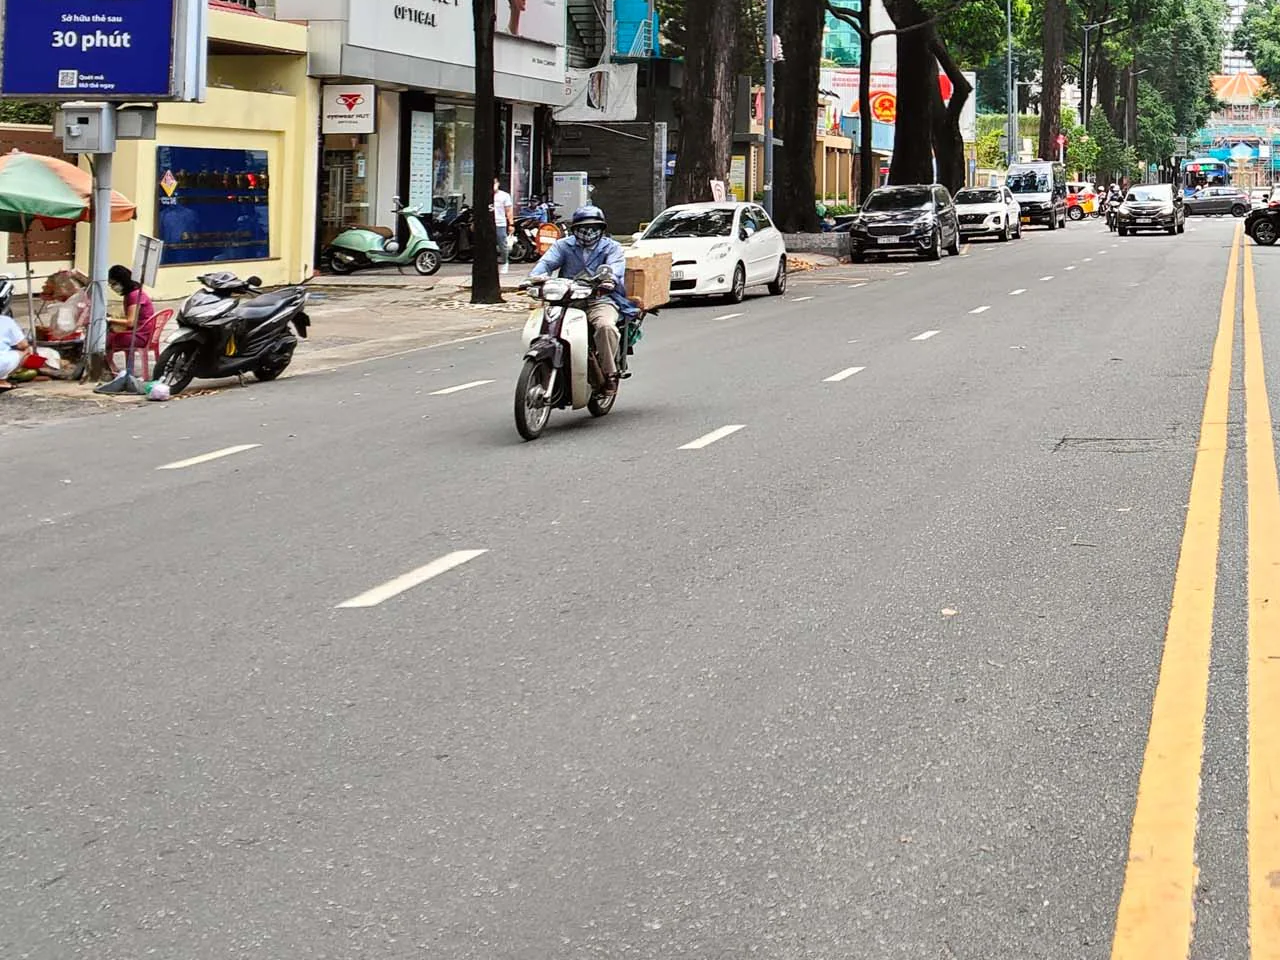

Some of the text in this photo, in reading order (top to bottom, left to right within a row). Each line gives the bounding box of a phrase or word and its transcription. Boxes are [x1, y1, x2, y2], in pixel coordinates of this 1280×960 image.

[394, 4, 438, 28] OPTICAL
[51, 30, 131, 52] 30 phút
